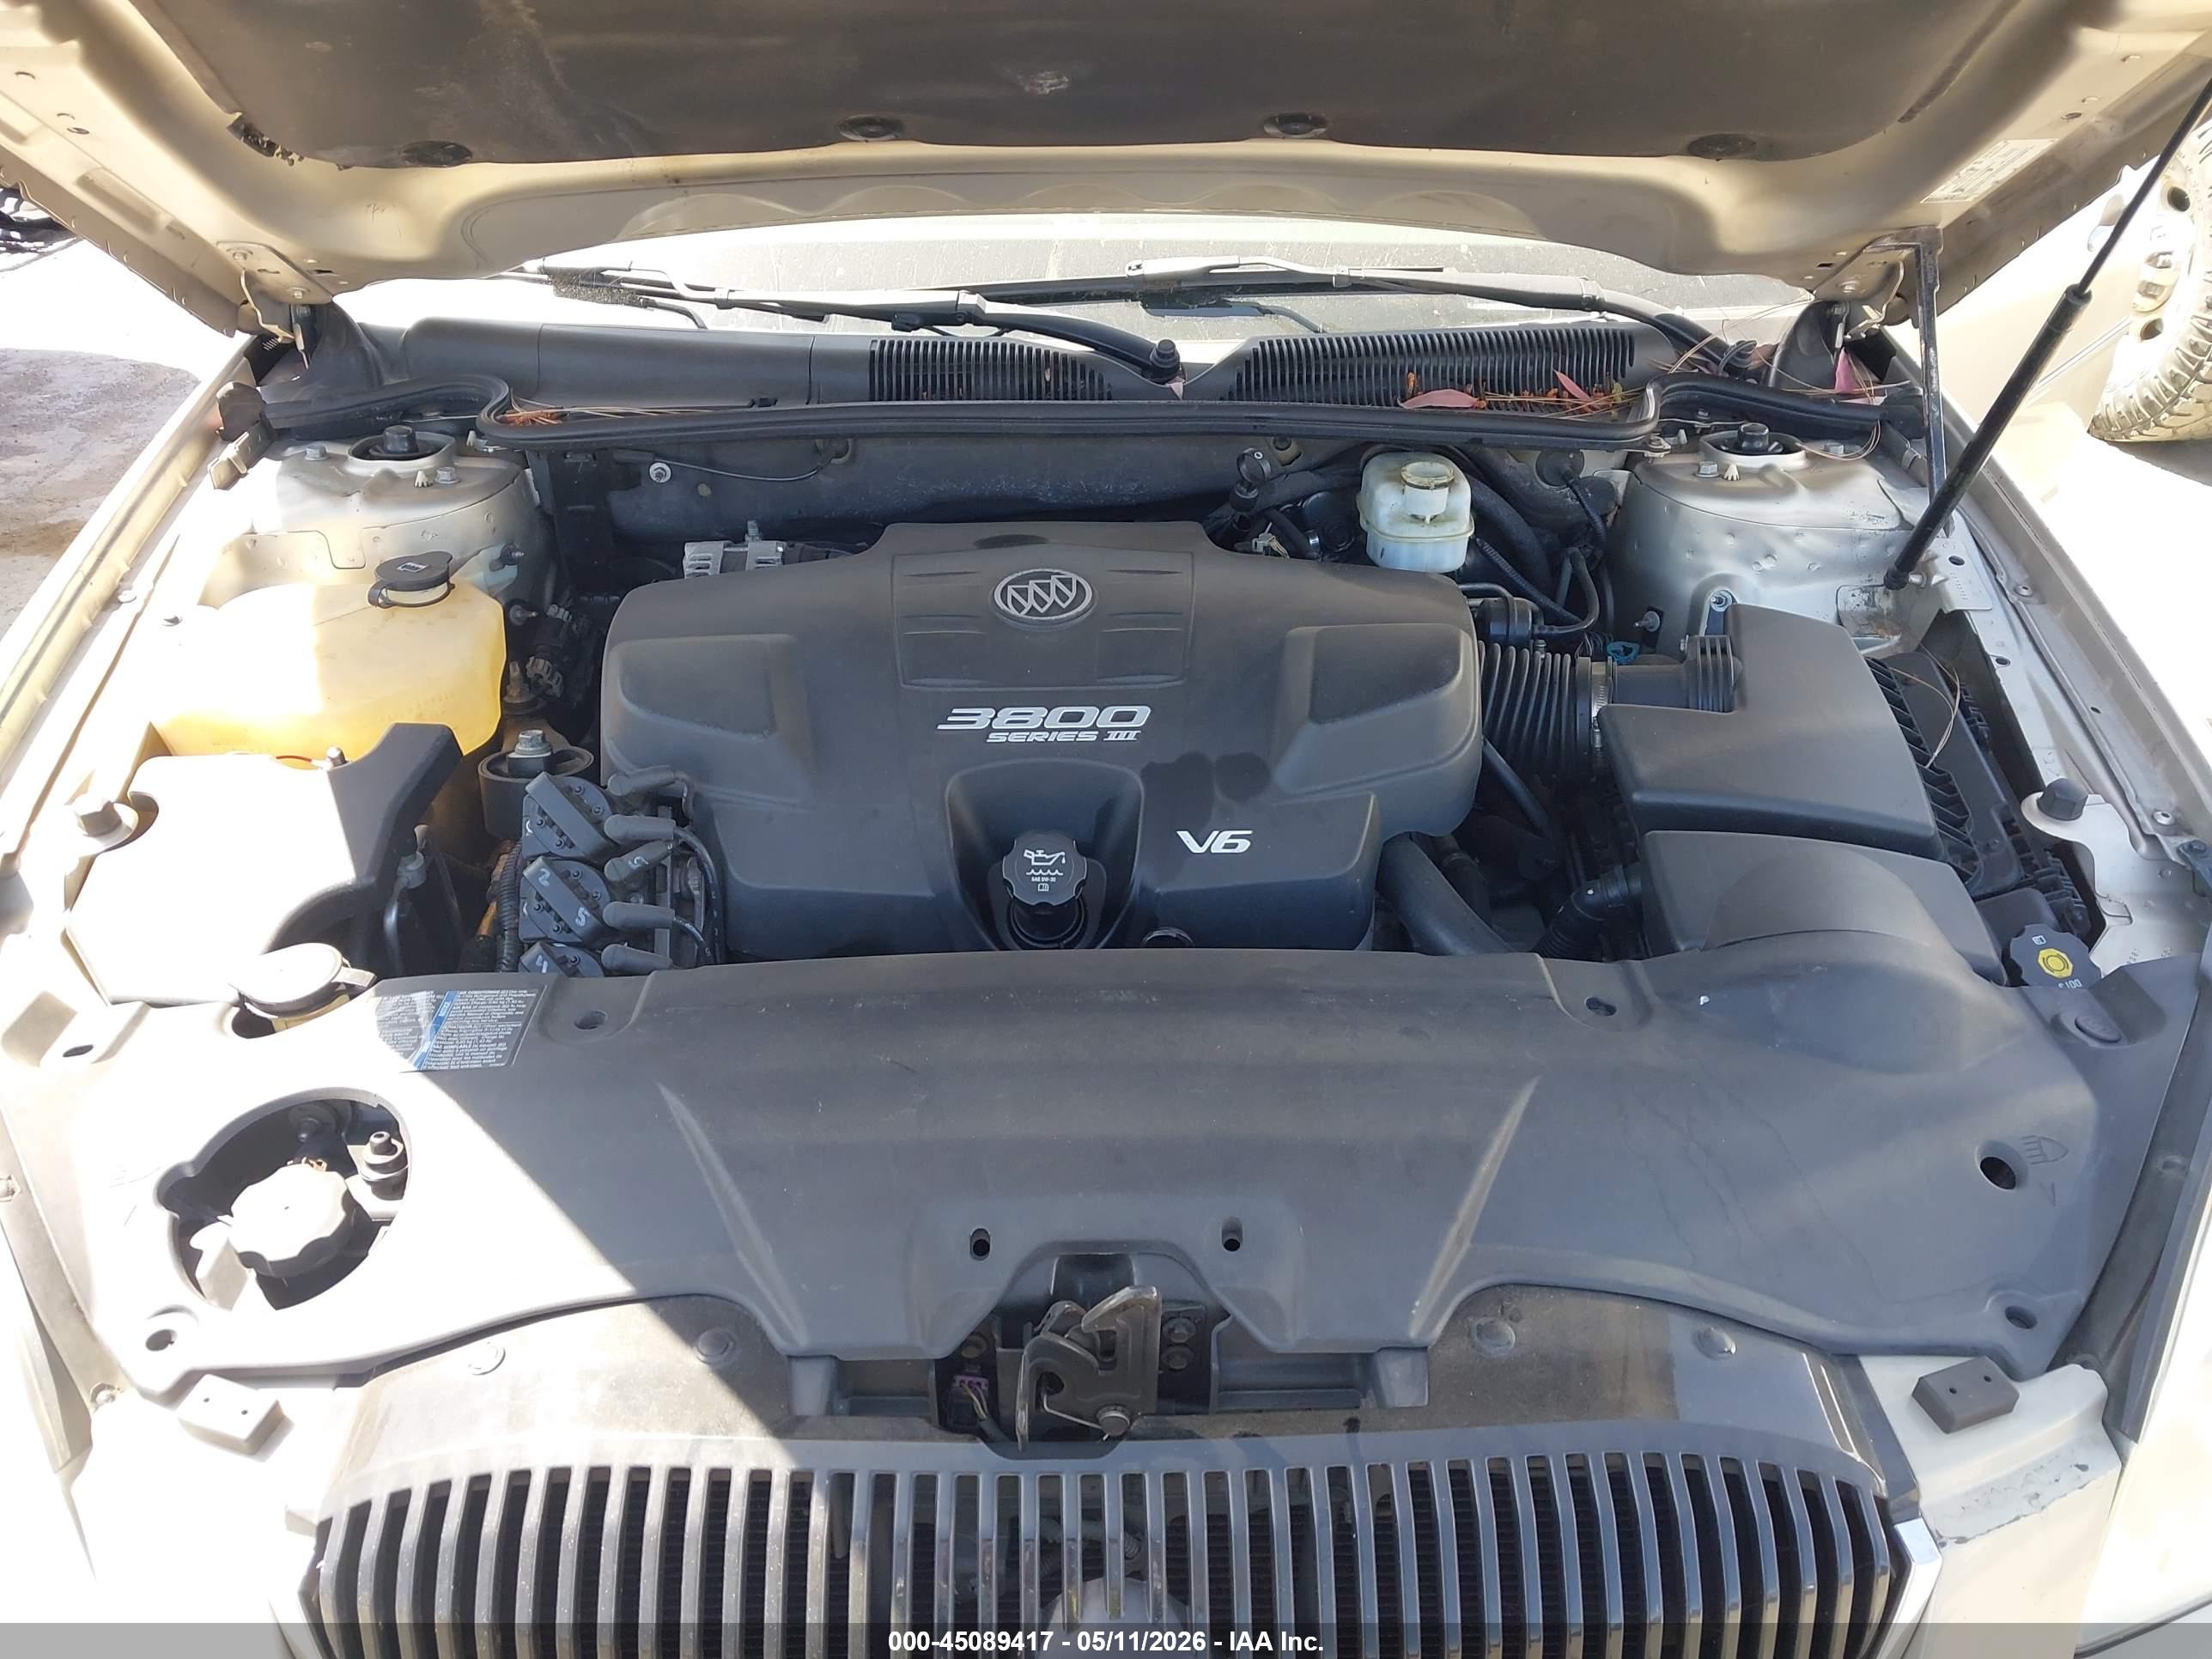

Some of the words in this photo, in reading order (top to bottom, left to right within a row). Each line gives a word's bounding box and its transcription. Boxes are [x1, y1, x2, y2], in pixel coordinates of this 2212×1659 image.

[937, 706, 1151, 730] 3800
[987, 731, 1099, 742] SERIES
[1103, 730, 1142, 741] III
[1176, 830, 1253, 854] V6
